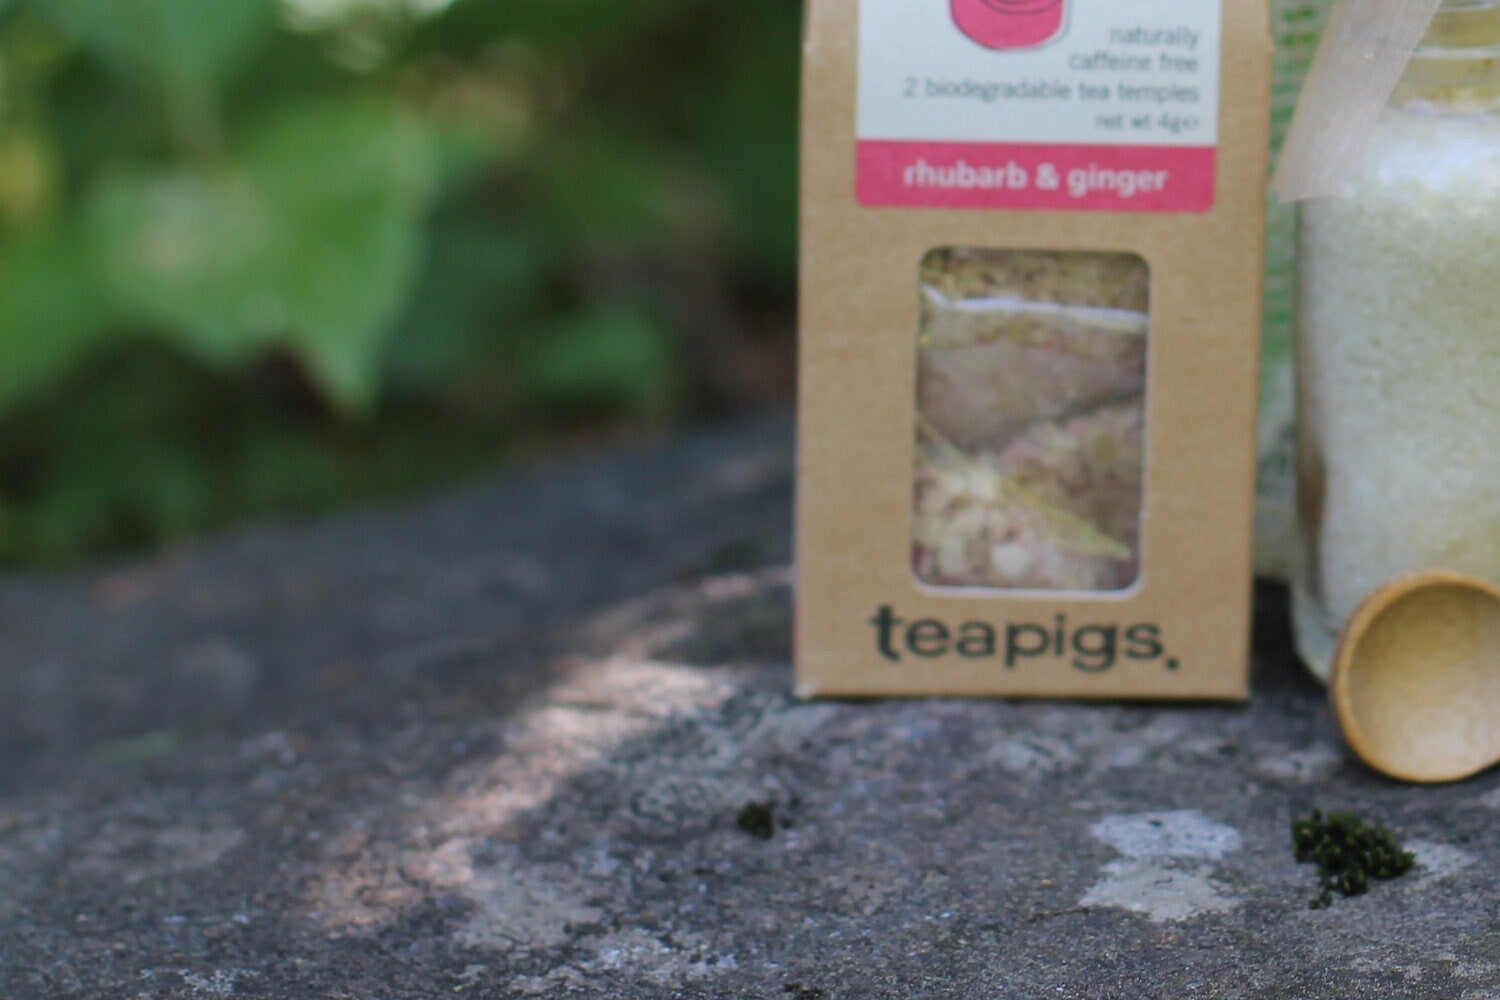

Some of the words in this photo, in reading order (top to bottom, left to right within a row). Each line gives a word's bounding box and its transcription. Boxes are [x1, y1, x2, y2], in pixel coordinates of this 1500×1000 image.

[1109, 25, 1199, 49] naturally
[1068, 50, 1152, 71] caffeine
[1159, 52, 1199, 73] free
[902, 75, 919, 98] 2
[924, 76, 1071, 102] biodegradable
[1078, 79, 1111, 100] tea
[1117, 80, 1199, 103] temples
[1095, 112, 1123, 130] net
[903, 159, 1028, 189] rhubarb
[1034, 162, 1060, 190] &
[1067, 163, 1169, 198] ginger
[870, 604, 1181, 673] teapigs.
